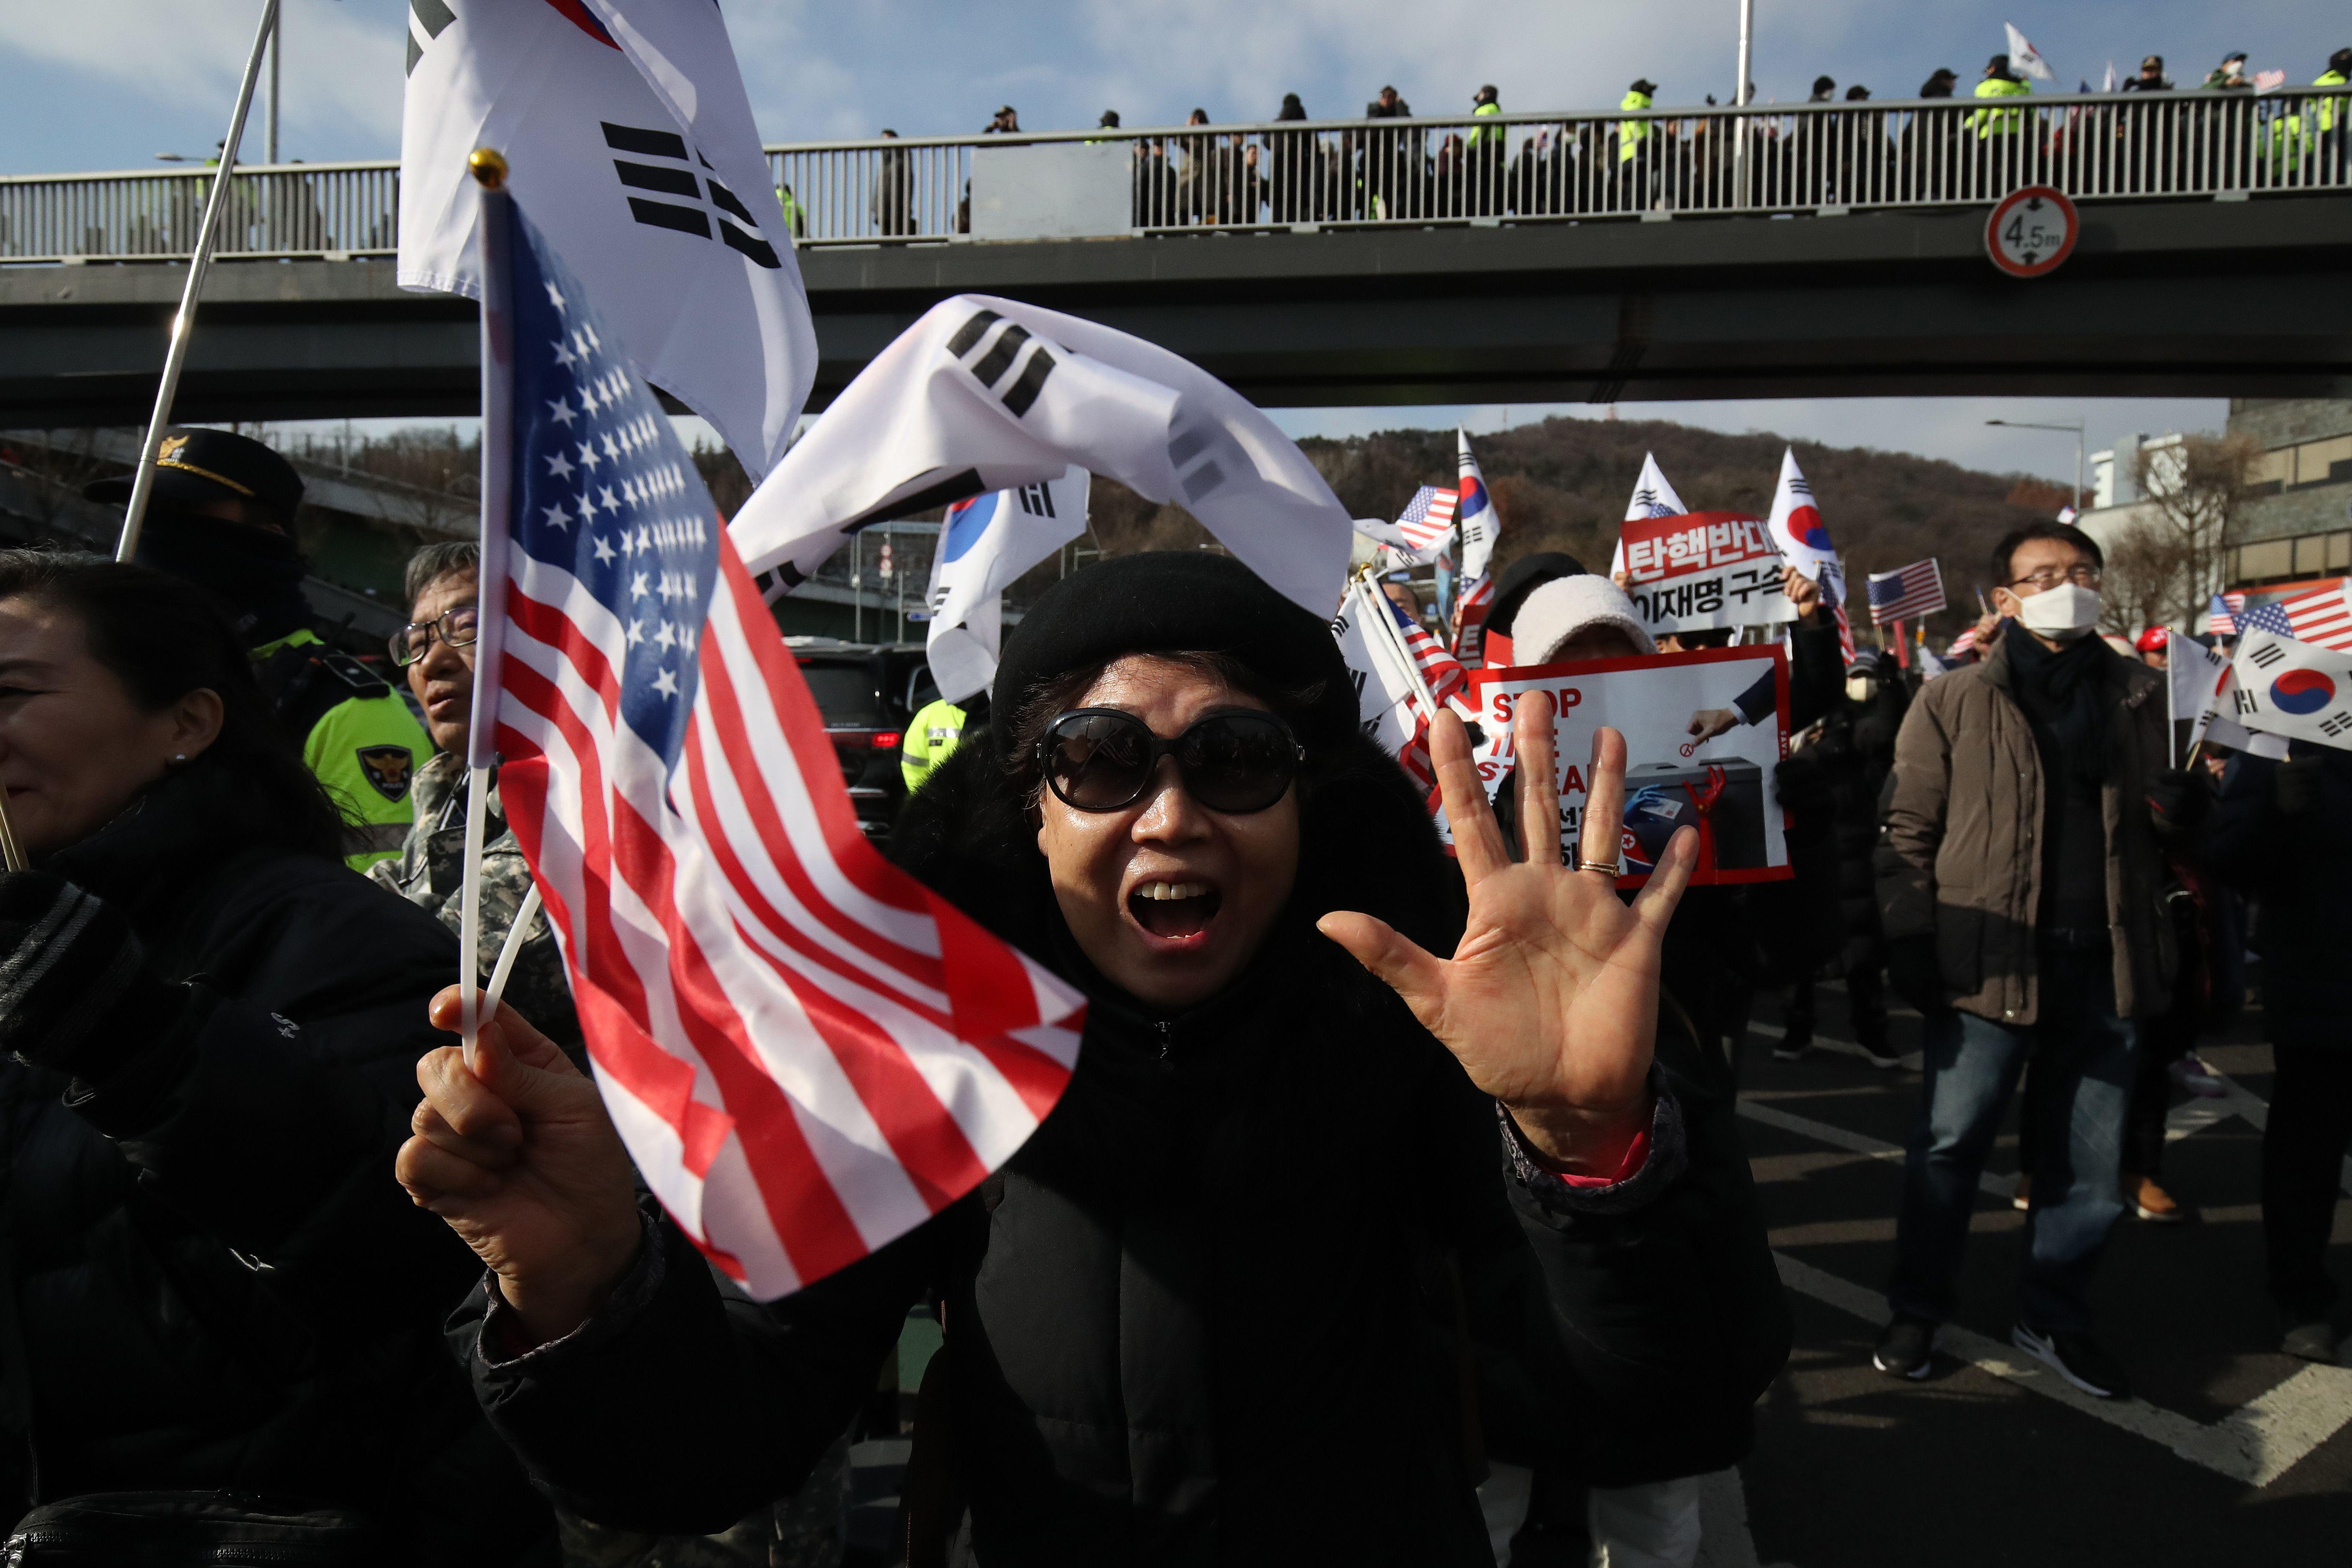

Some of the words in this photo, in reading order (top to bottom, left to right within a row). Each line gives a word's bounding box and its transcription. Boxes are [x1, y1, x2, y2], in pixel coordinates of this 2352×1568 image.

[2005, 215, 2061, 249] 4.5m
[1628, 519, 1780, 581] 탄핵반대
[1634, 576, 1723, 623] 이재명
[1493, 688, 1582, 722] SP
